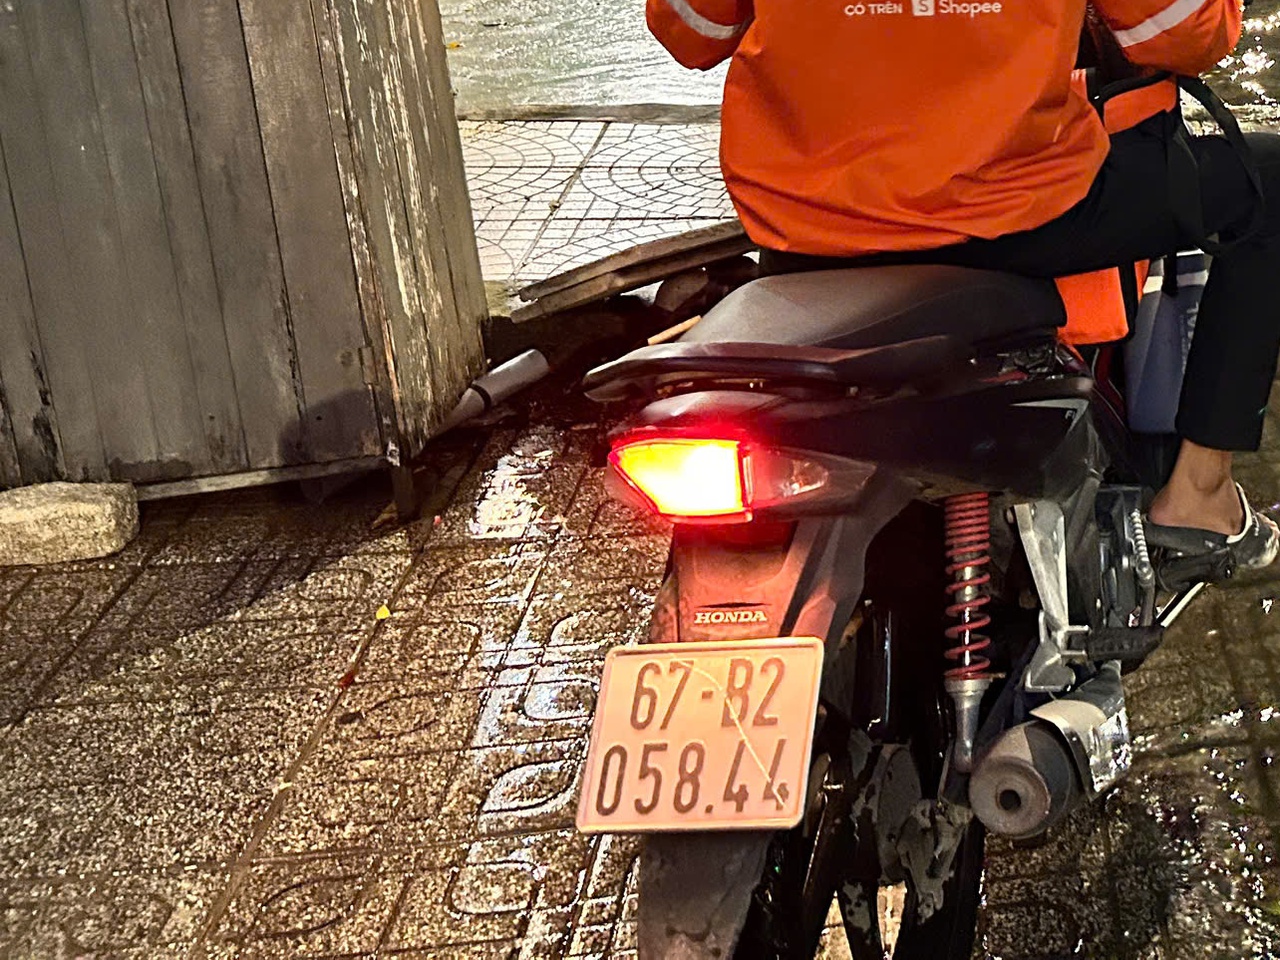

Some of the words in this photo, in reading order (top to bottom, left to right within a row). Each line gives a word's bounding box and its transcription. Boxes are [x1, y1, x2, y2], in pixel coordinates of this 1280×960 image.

[845, 0, 865, 16] CÓ
[868, 0, 902, 15] TRÊN
[694, 611, 768, 624] HONDA
[630, 657, 787, 731] 67-B2
[595, 739, 790, 817] 058.44
